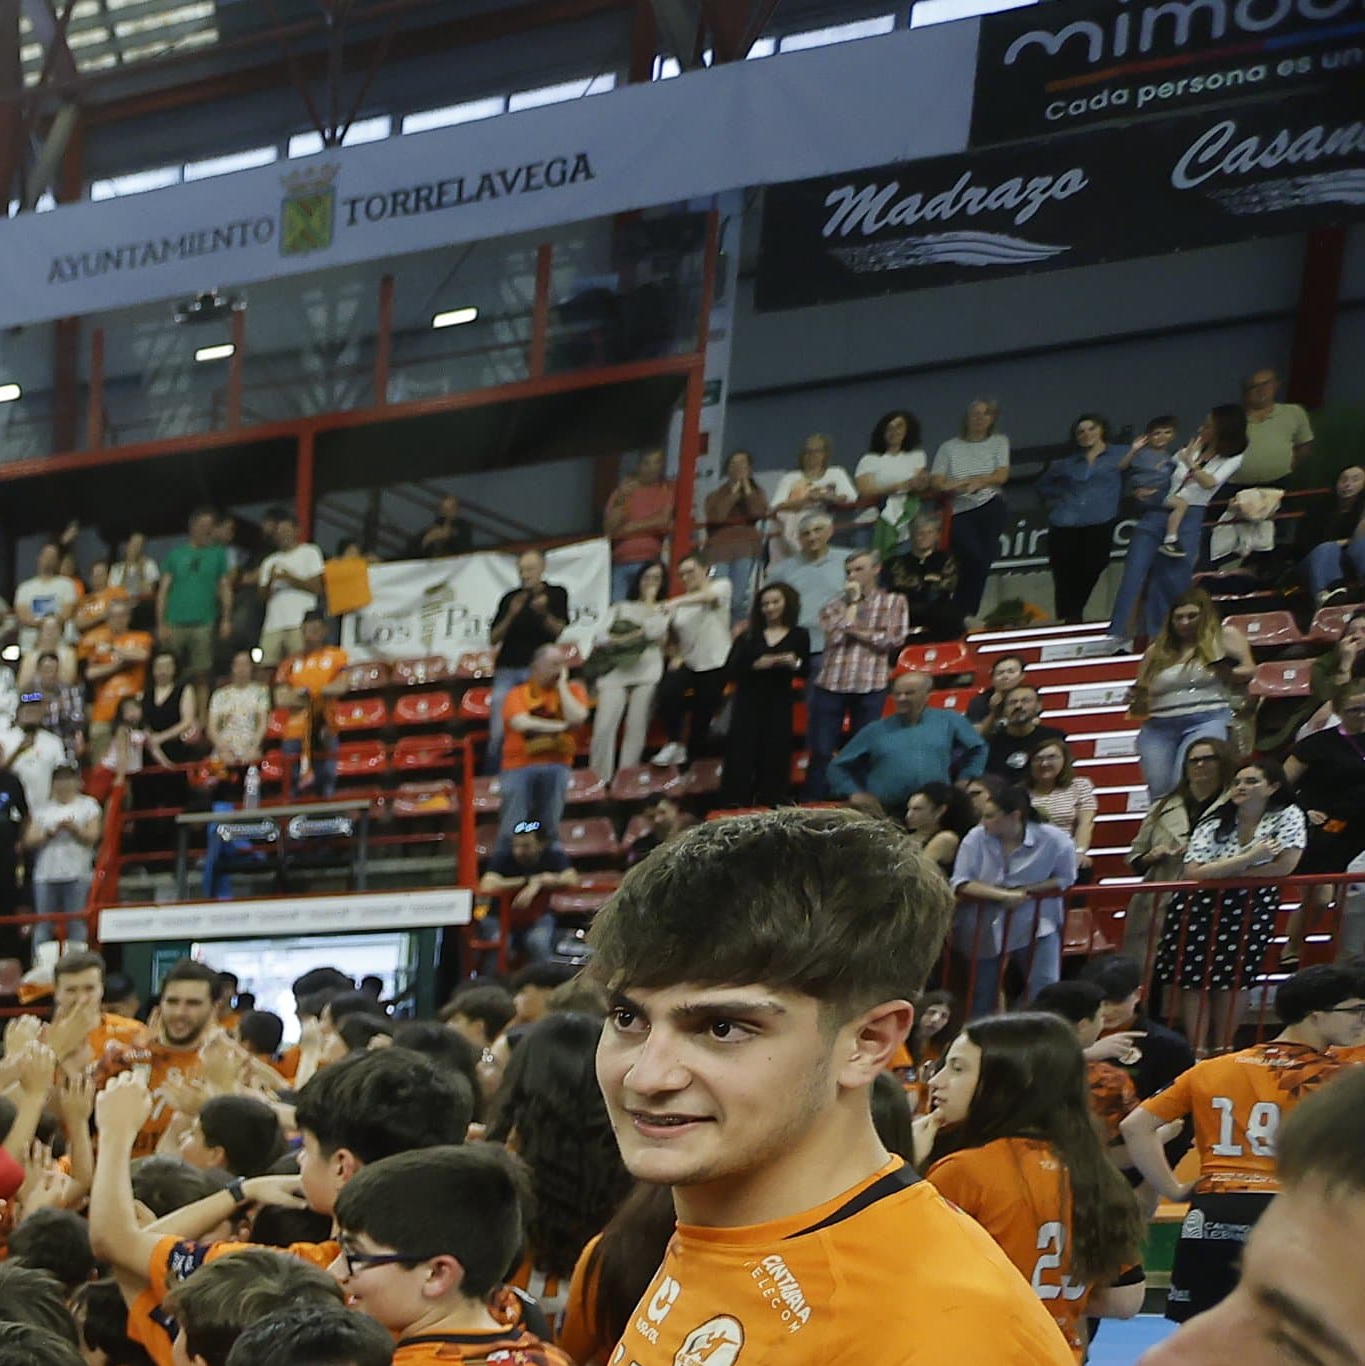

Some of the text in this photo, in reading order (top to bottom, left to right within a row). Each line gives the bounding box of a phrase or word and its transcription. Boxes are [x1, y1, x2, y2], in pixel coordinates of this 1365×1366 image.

[1045, 87, 1130, 121] Cada
[1136, 63, 1268, 108] persona
[46, 151, 597, 285] AYUNTAMIENTO TORRELAVEGA
[821, 166, 1090, 238] Madrazo
